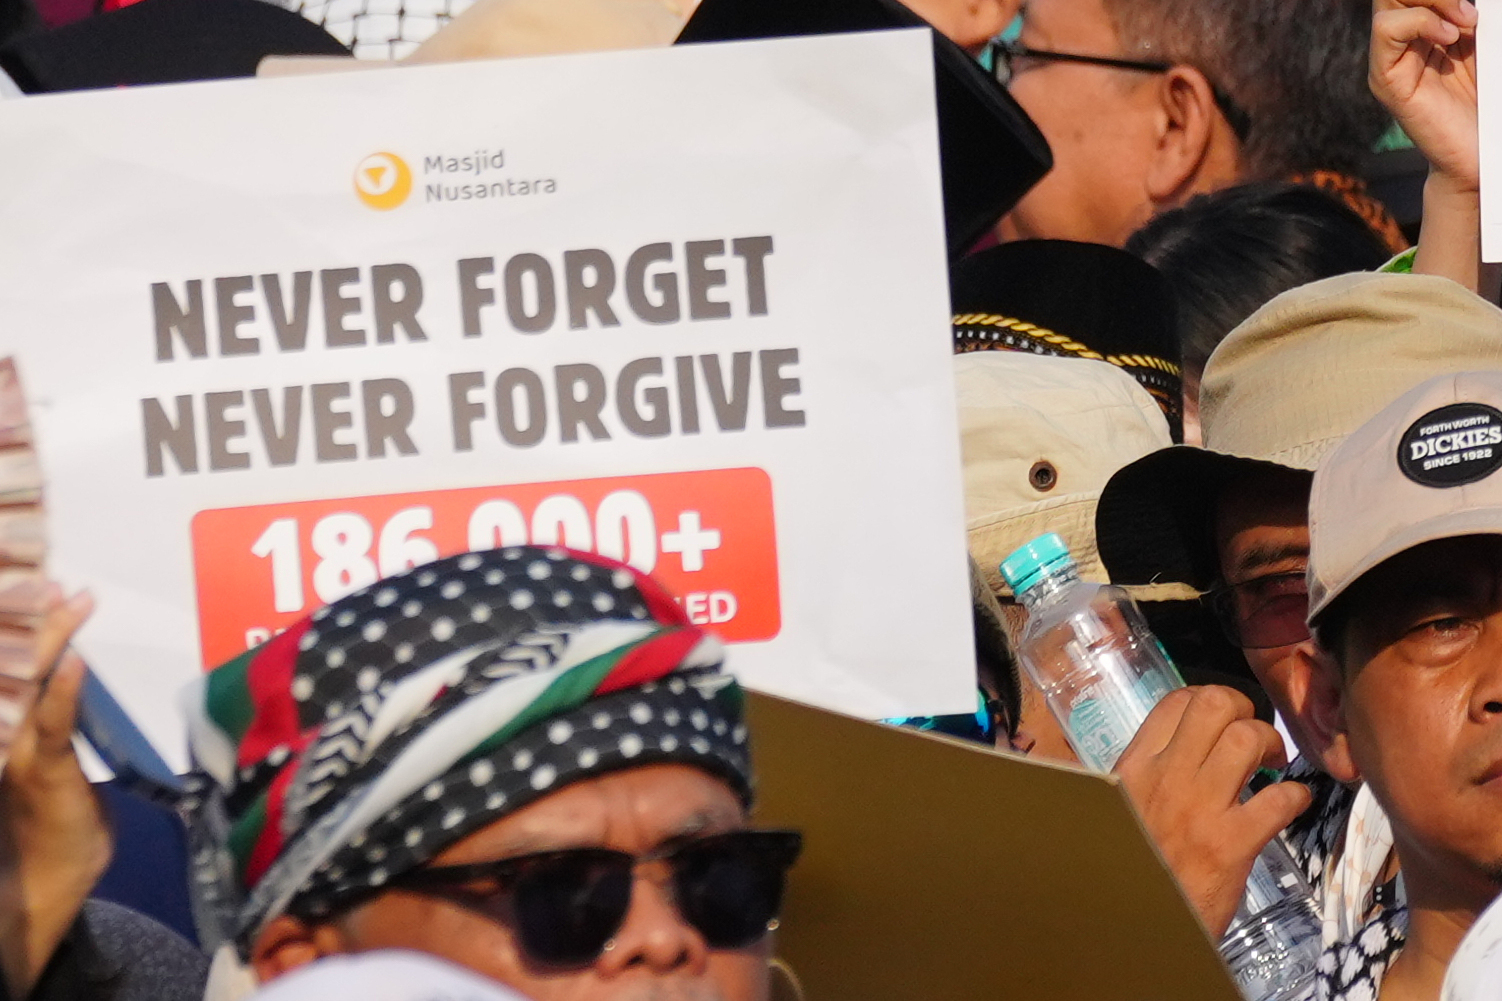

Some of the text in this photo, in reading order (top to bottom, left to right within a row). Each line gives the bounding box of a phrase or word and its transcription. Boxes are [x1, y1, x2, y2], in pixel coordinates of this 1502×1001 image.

[423, 149, 506, 177] Masjid
[424, 172, 558, 202] Nusantara
[151, 235, 775, 362] NEVER FORGET
[142, 347, 807, 478] NEVER FORGIVE
[1410, 427, 1502, 461] DICKIES
[1423, 448, 1493, 470] SINCE 1922
